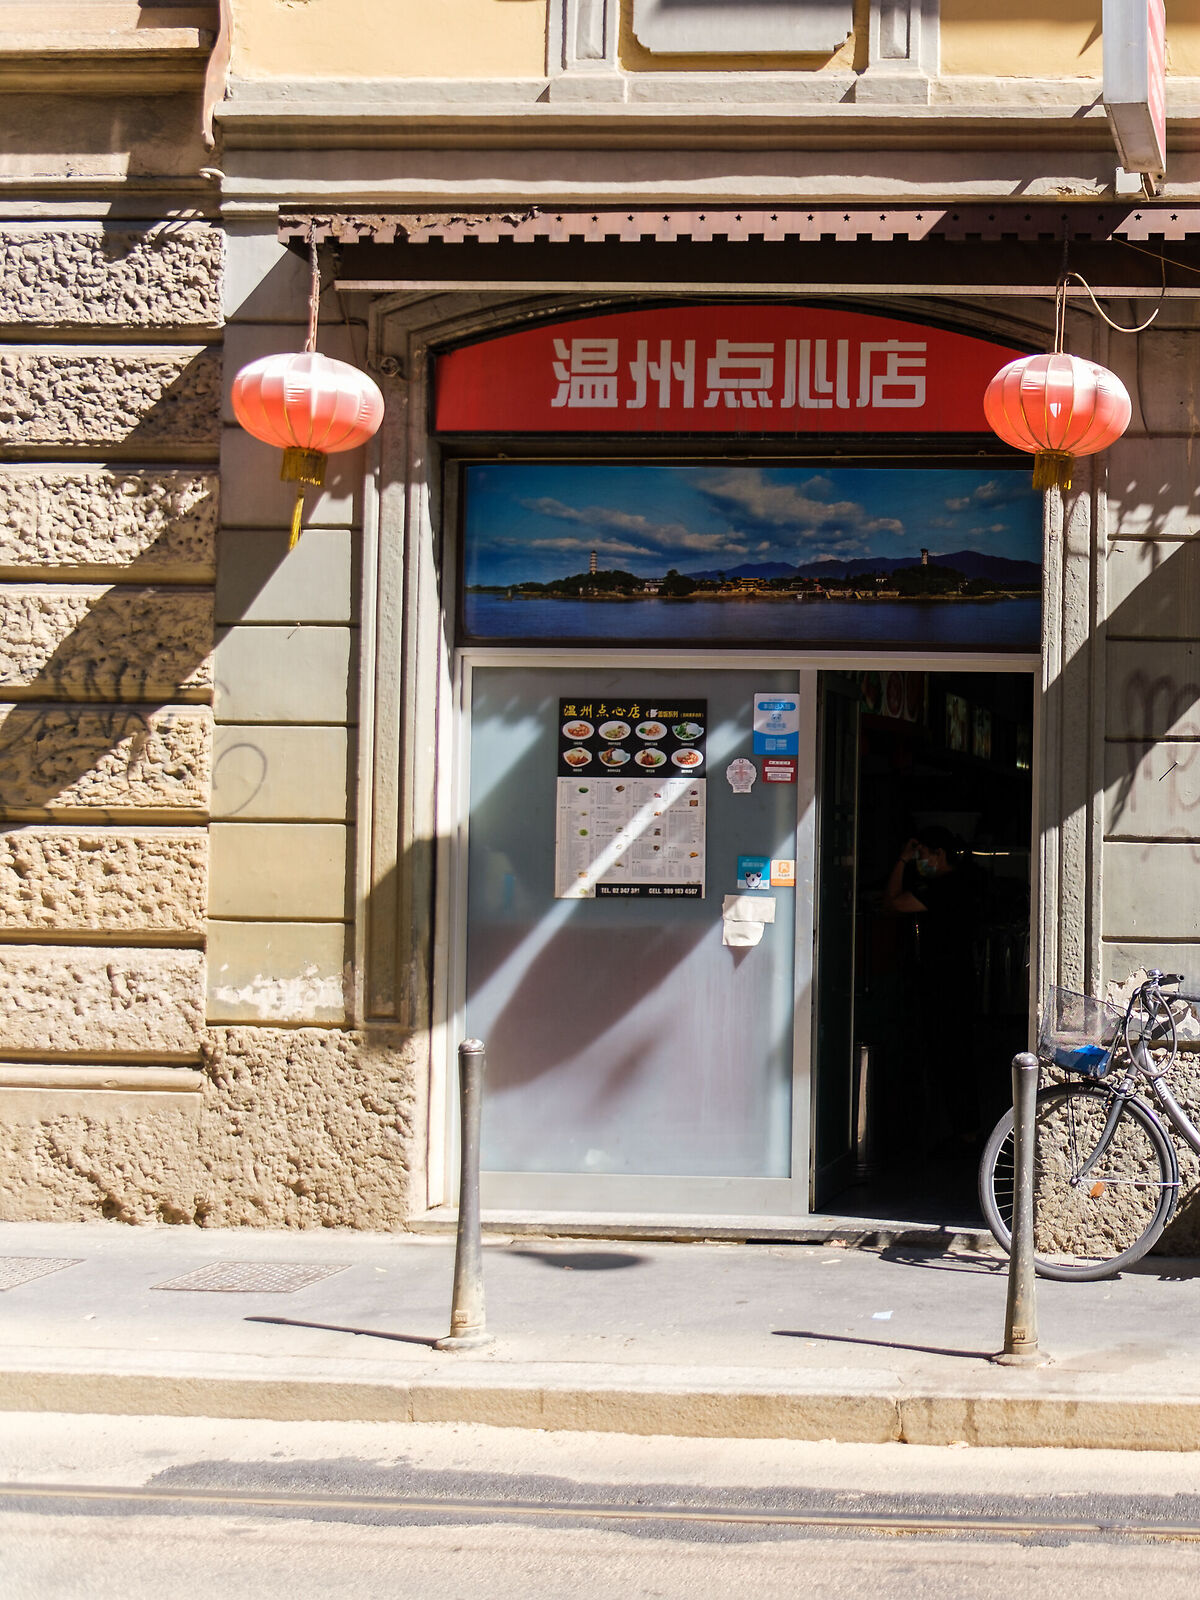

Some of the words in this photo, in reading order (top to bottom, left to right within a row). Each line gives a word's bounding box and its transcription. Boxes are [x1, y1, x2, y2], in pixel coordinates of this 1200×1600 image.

[551, 338, 927, 409] 温州点心店
[563, 703, 641, 719] 温州点心店
